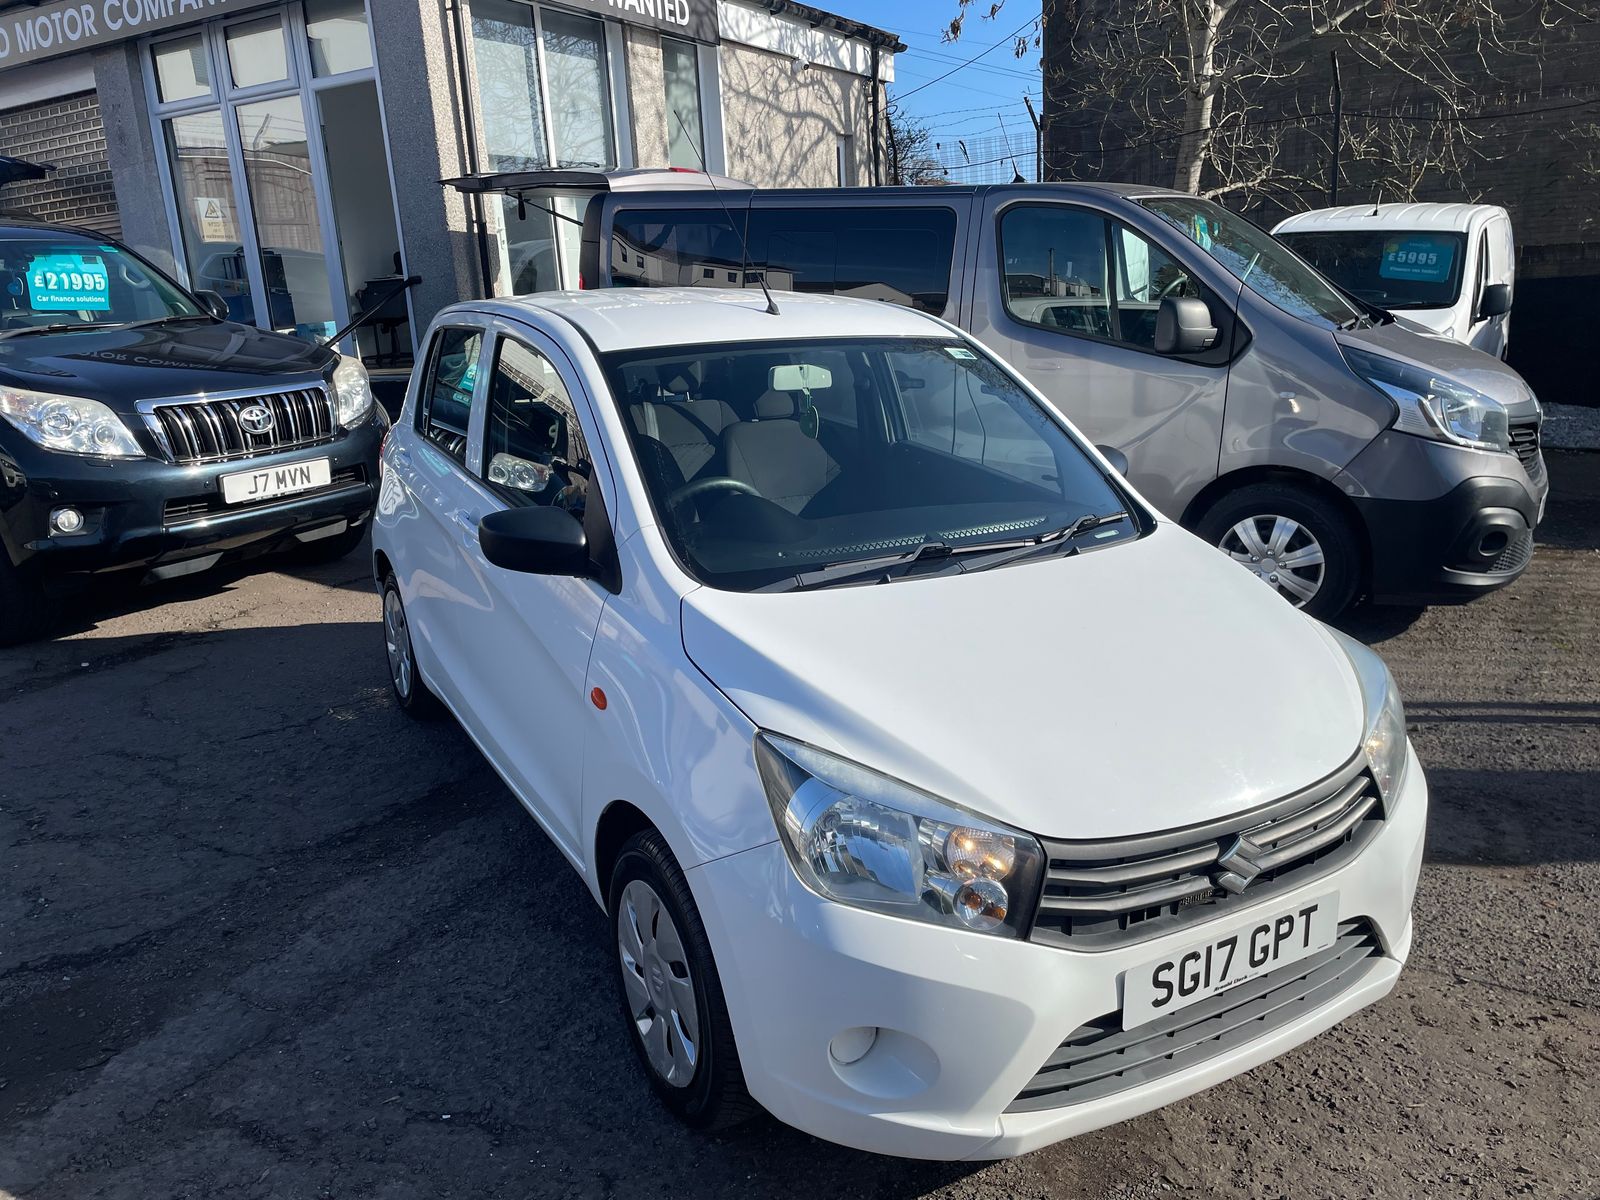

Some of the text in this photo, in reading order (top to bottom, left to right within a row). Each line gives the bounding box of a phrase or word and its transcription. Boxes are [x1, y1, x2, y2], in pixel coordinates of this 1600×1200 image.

[606, 0, 690, 26] ANTED
[14, 4, 99, 53] MOTOR
[103, 0, 226, 31] COMPA
[1388, 251, 1438, 265] £5995
[34, 272, 106, 290] £21995
[50, 295, 75, 303] finance
[248, 473, 270, 495] J7
[275, 466, 311, 489] MVN
[1151, 904, 1319, 1008] SG17 GPT
